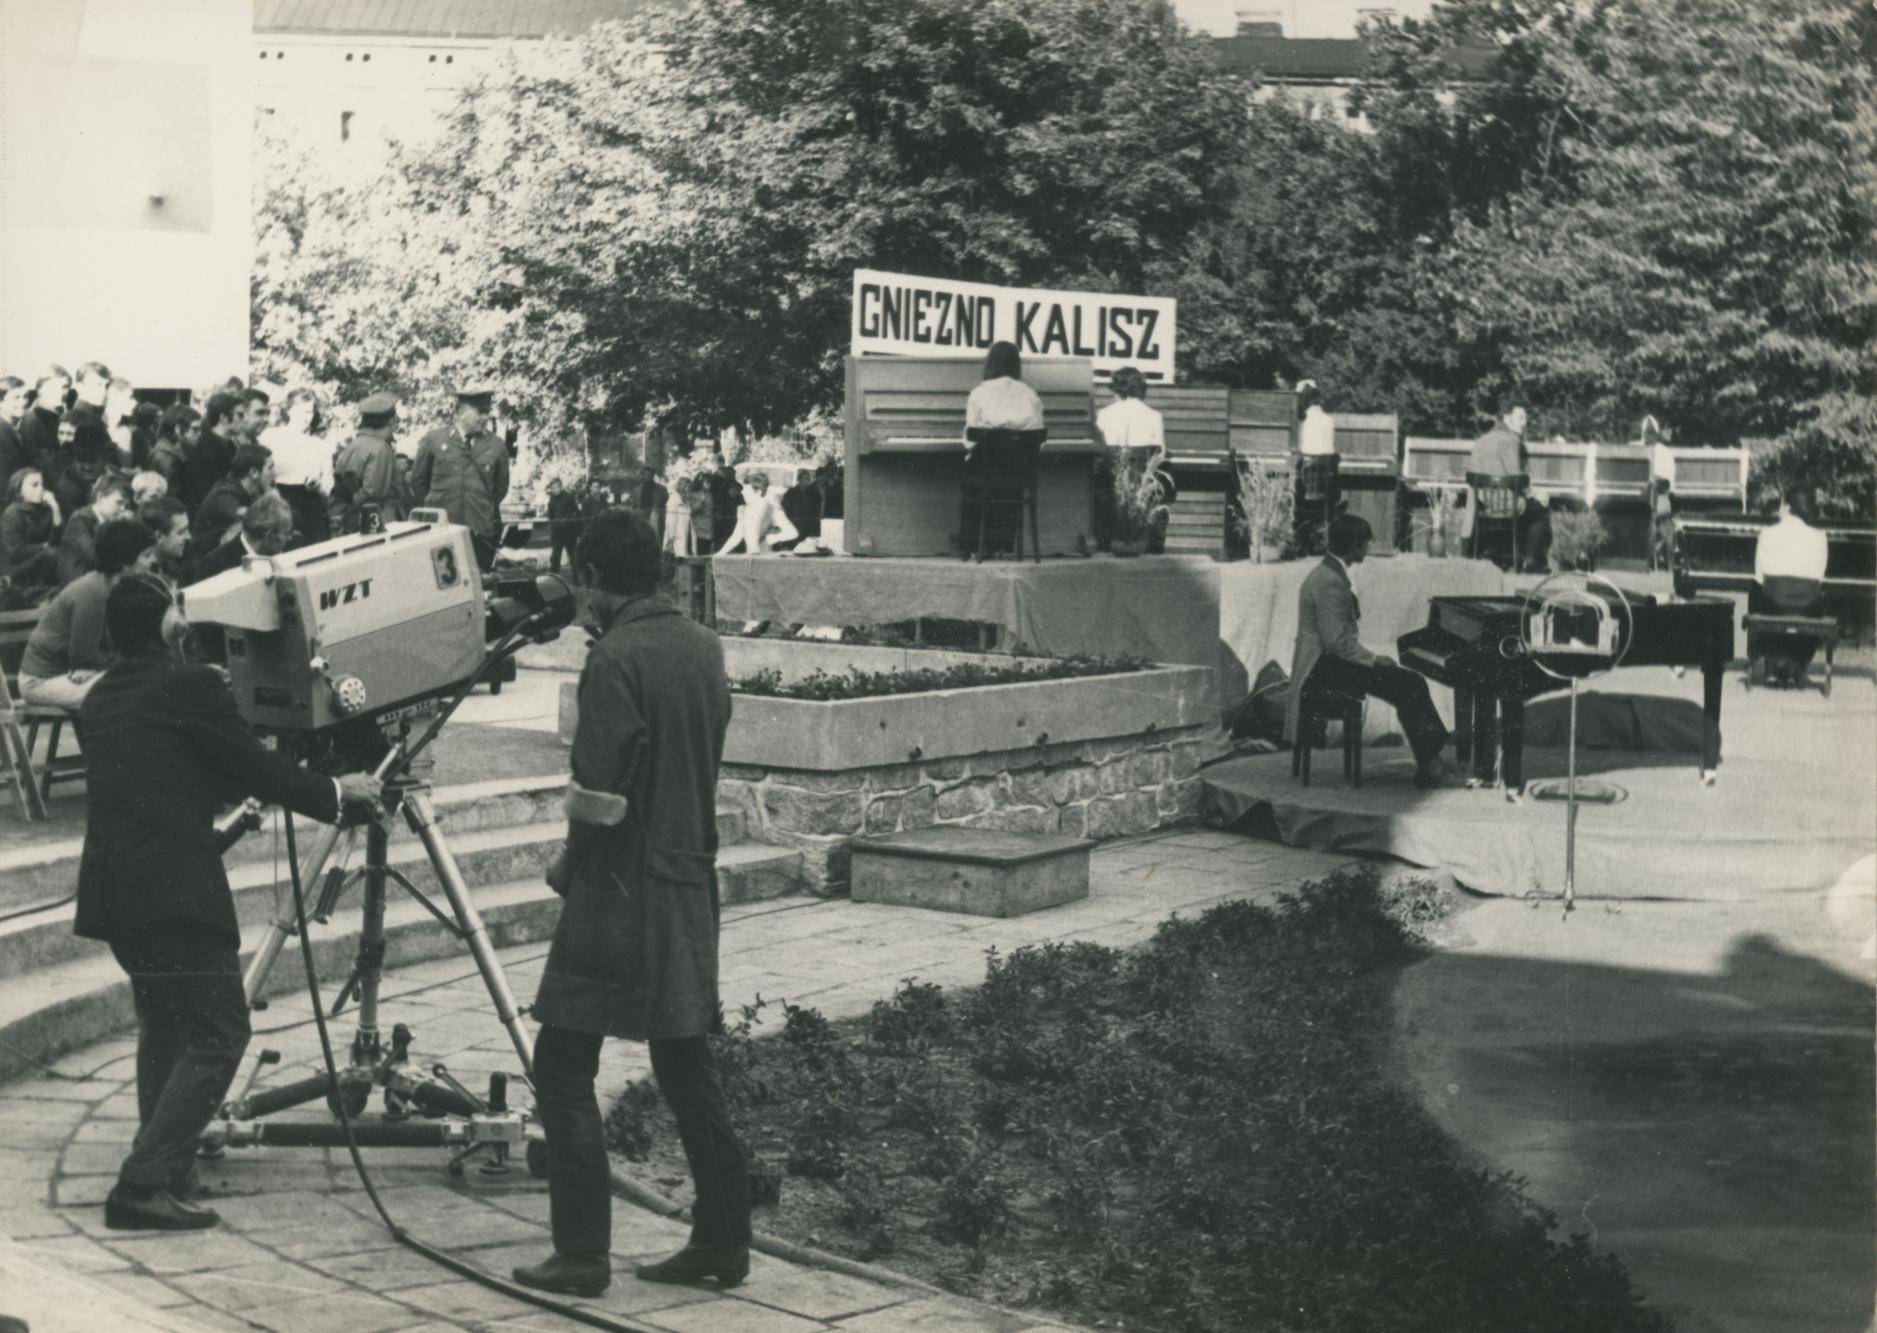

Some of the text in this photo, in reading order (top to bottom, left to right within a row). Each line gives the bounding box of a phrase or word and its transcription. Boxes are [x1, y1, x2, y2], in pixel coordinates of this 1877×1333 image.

[859, 282, 1160, 360] GNIEZNO KALISZ
[369, 512, 380, 528] 3
[437, 547, 457, 584] 3
[320, 577, 373, 610] WZT
